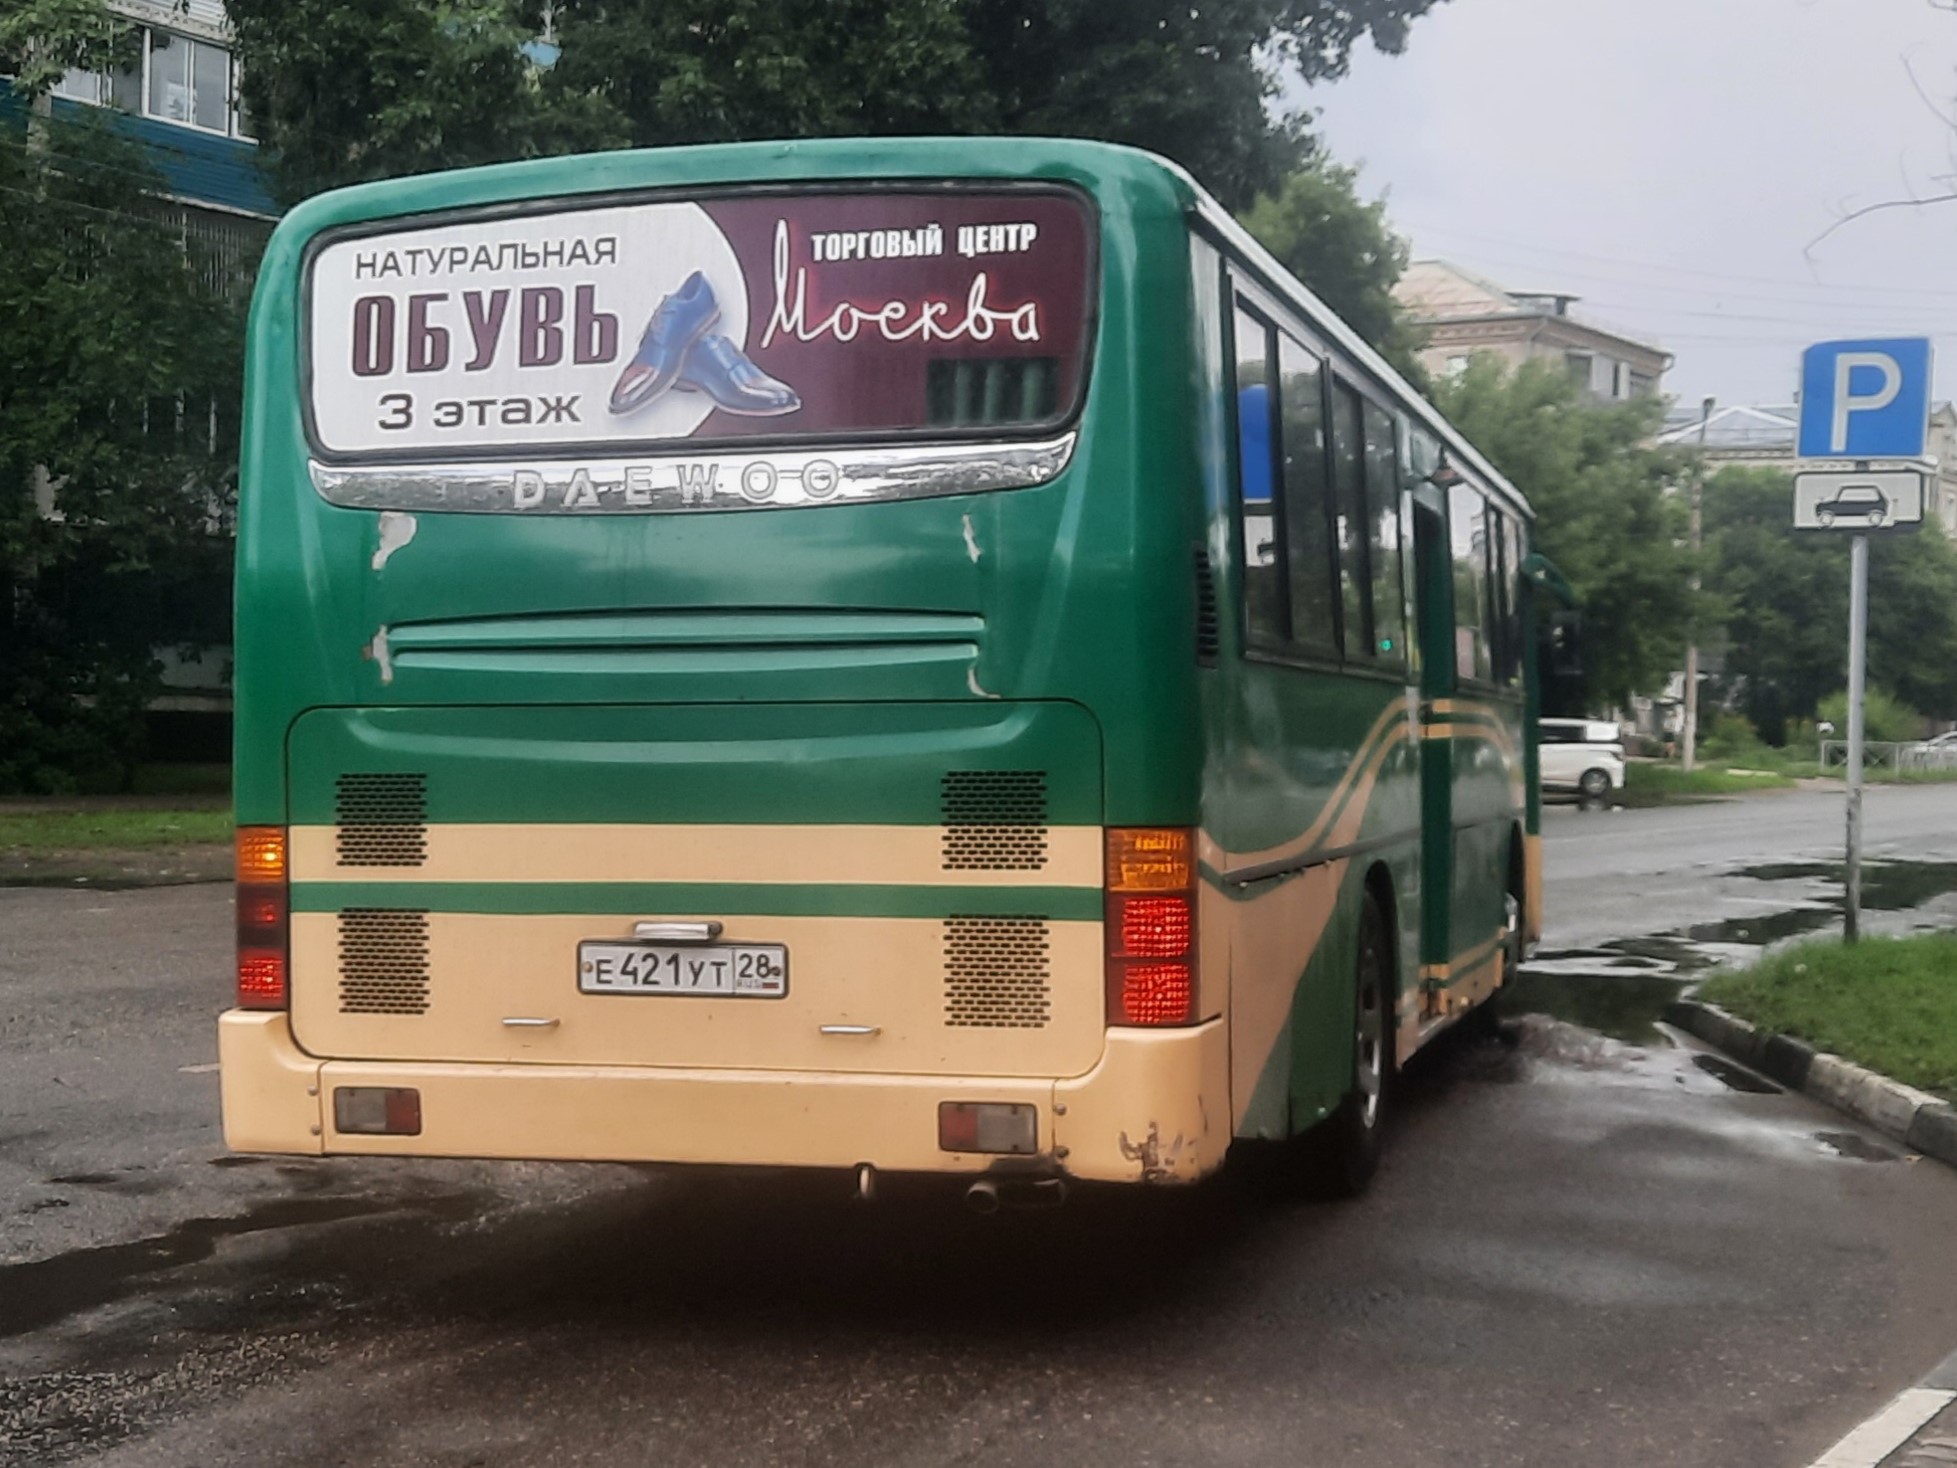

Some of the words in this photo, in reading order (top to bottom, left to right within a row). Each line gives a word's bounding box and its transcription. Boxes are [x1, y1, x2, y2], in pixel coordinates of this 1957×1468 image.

[355, 237, 618, 279] НАТУРАЛЬНАЯ
[811, 223, 944, 262] ТОРГОВЫЙ
[958, 223, 1038, 258] ЦЕНТР
[761, 218, 1041, 349] Москва
[352, 284, 620, 378] ОБУВЬ
[377, 393, 414, 430] 3
[433, 395, 583, 428] этаж
[1831, 353, 1902, 453] P
[513, 459, 840, 509] DAEWOO
